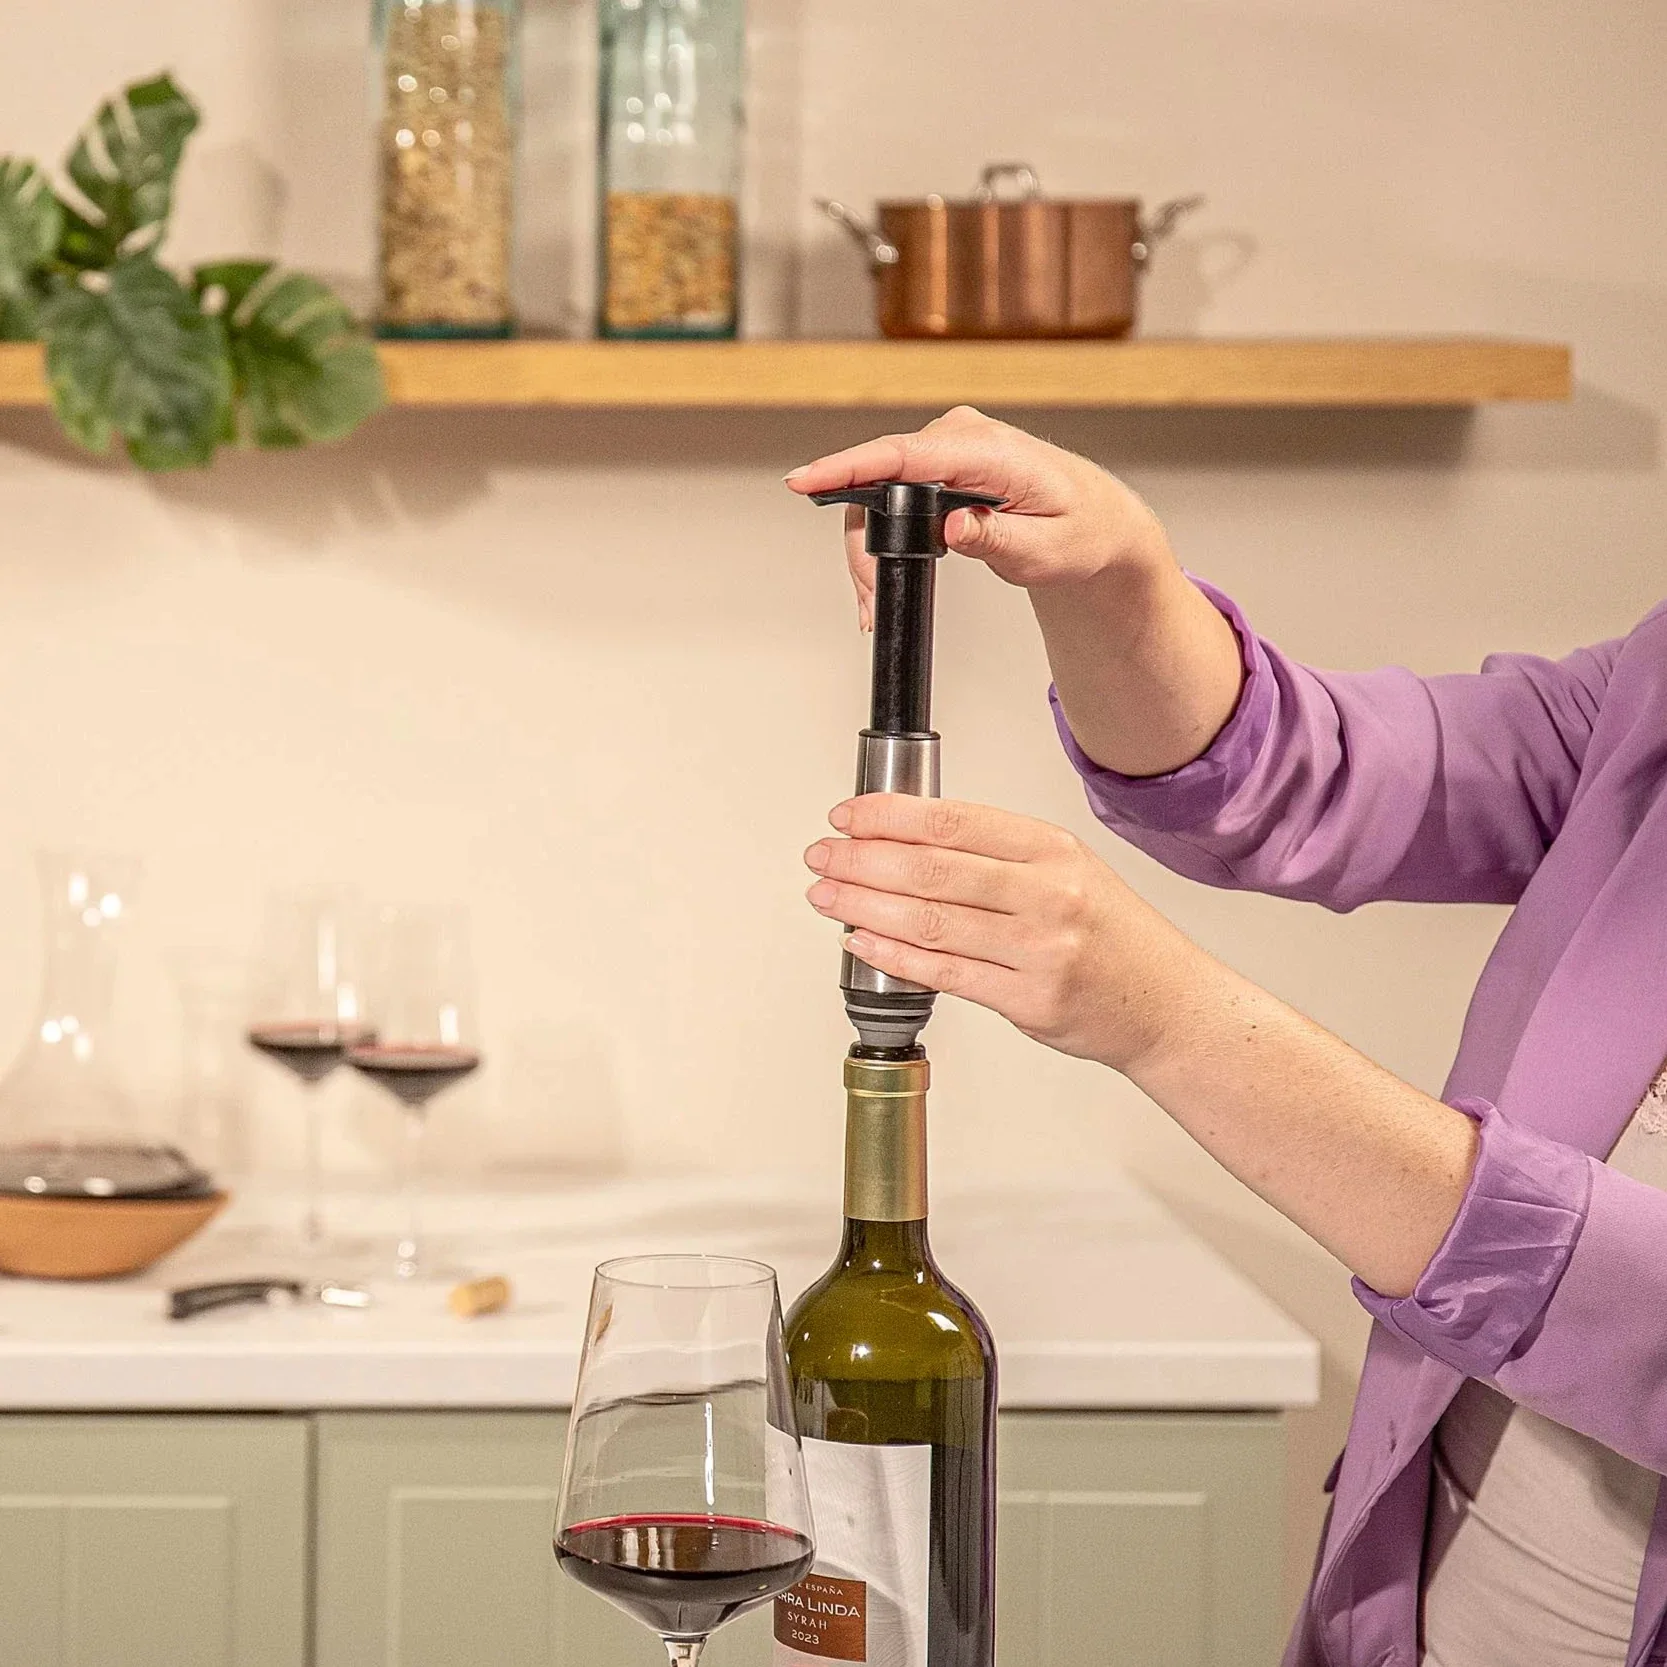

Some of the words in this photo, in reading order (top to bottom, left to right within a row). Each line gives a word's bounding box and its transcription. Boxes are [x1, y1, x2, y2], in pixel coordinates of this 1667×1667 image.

[805, 1582, 844, 1596] ESPAÑA
[777, 1592, 804, 1609] RRA
[807, 1597, 861, 1618] LINDA
[787, 1611, 827, 1630] SYRAH
[791, 1629, 820, 1645] 2023
